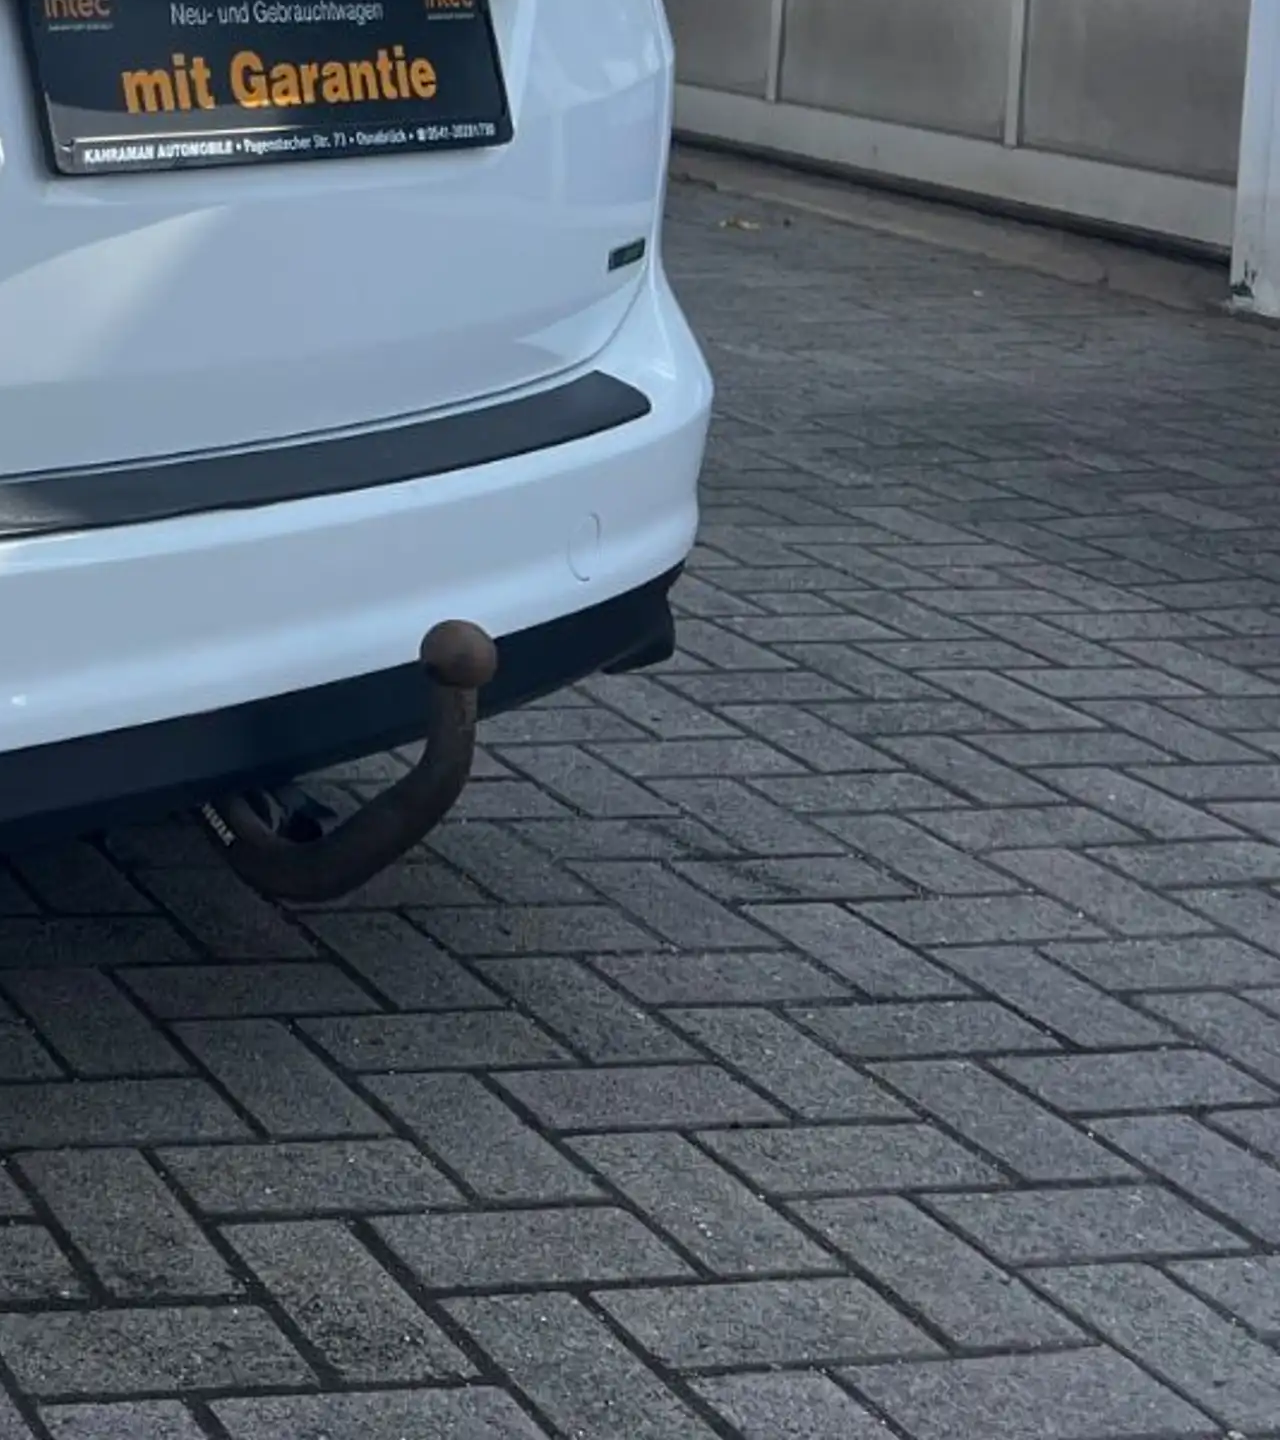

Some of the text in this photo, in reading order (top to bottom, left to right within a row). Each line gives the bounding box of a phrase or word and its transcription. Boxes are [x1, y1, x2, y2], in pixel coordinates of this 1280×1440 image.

[170, 0, 384, 26] Neu- und Gebrauchtwagen
[121, 45, 437, 113] mit Garantie
[83, 144, 155, 164] KAHRAMAN
[157, 140, 233, 160] AUTOMOBILE
